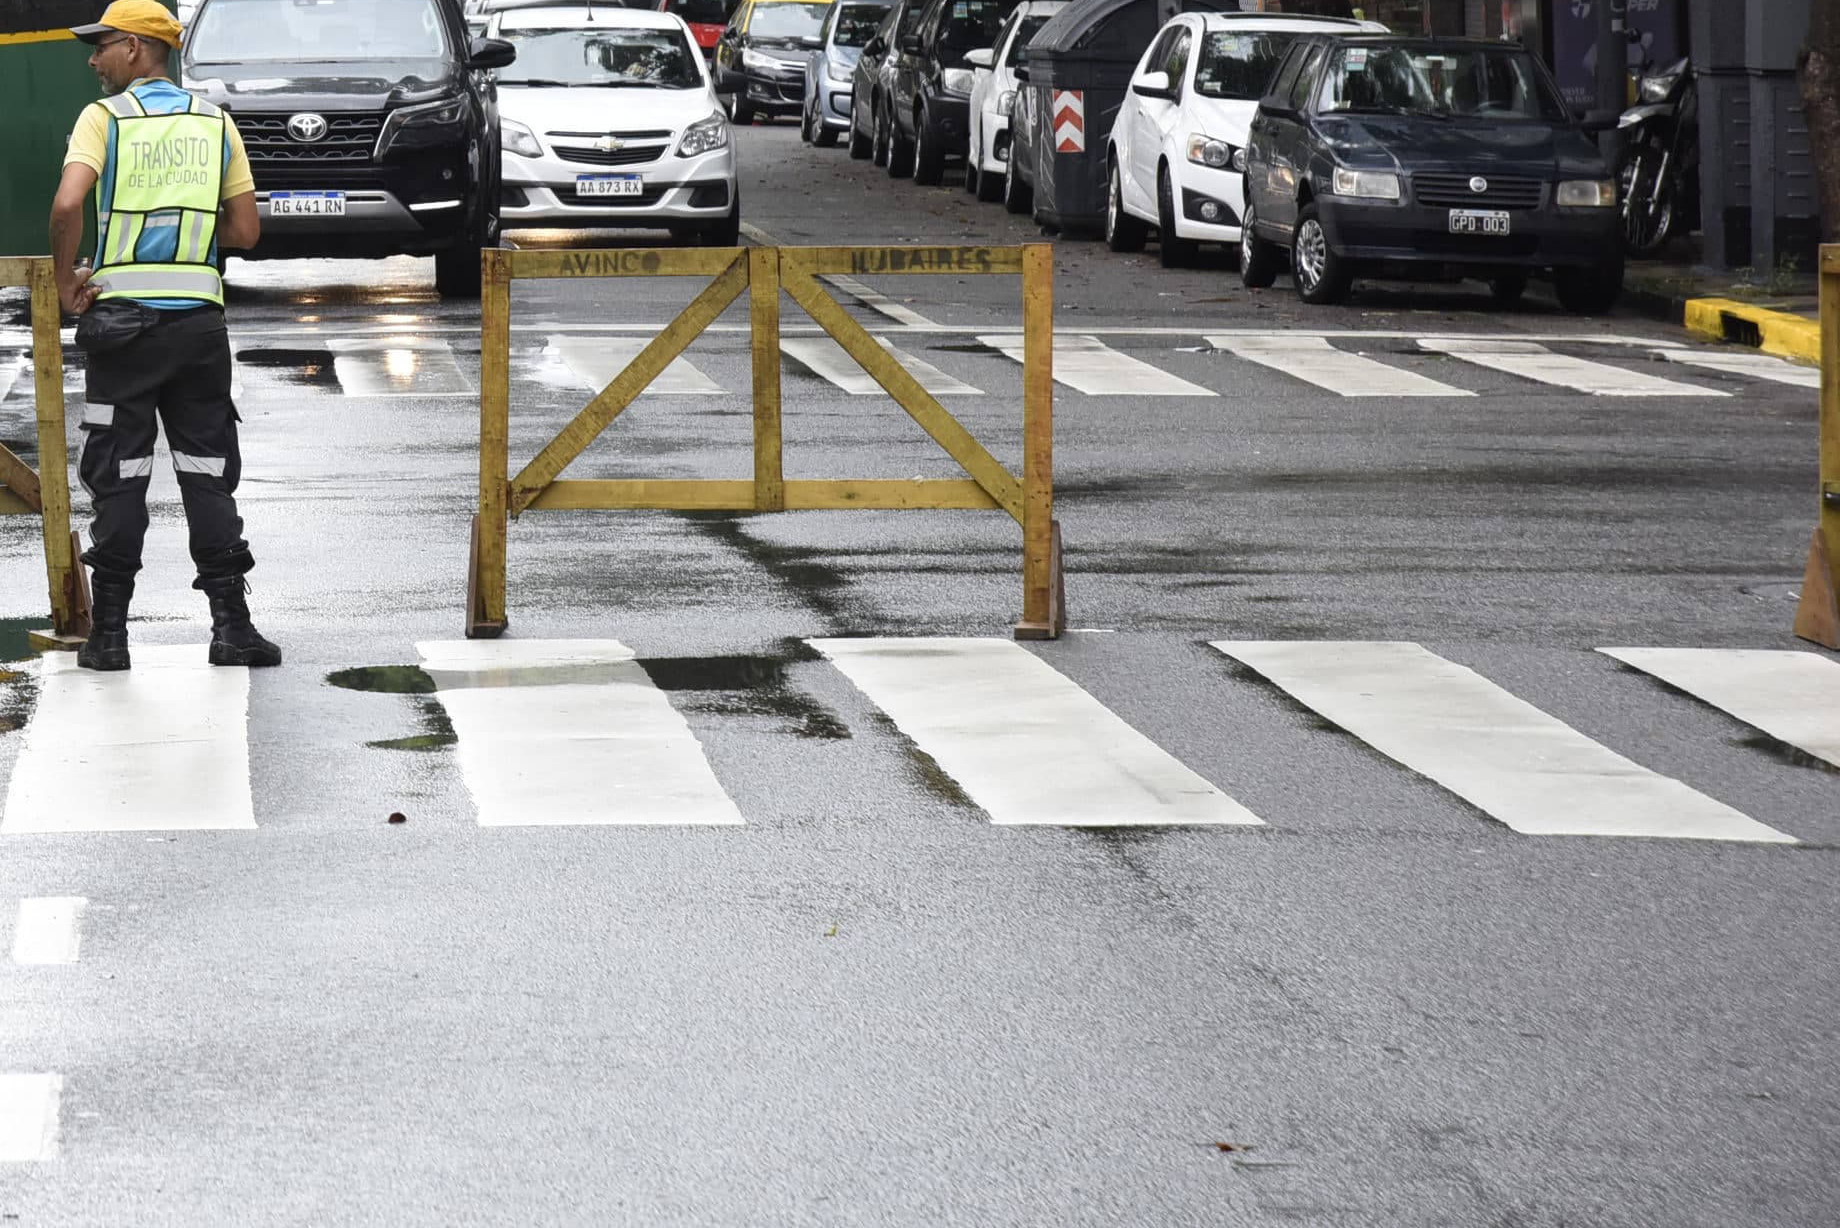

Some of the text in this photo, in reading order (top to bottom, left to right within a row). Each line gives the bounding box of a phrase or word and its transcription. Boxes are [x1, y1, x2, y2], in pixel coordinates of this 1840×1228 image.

[131, 137, 209, 171] TRANSITO
[128, 170, 208, 188] DE LA CIUDAD
[580, 181, 639, 193] AA 873 RX
[274, 200, 342, 213] AG 441 RN
[1452, 216, 1507, 232] GPD 003
